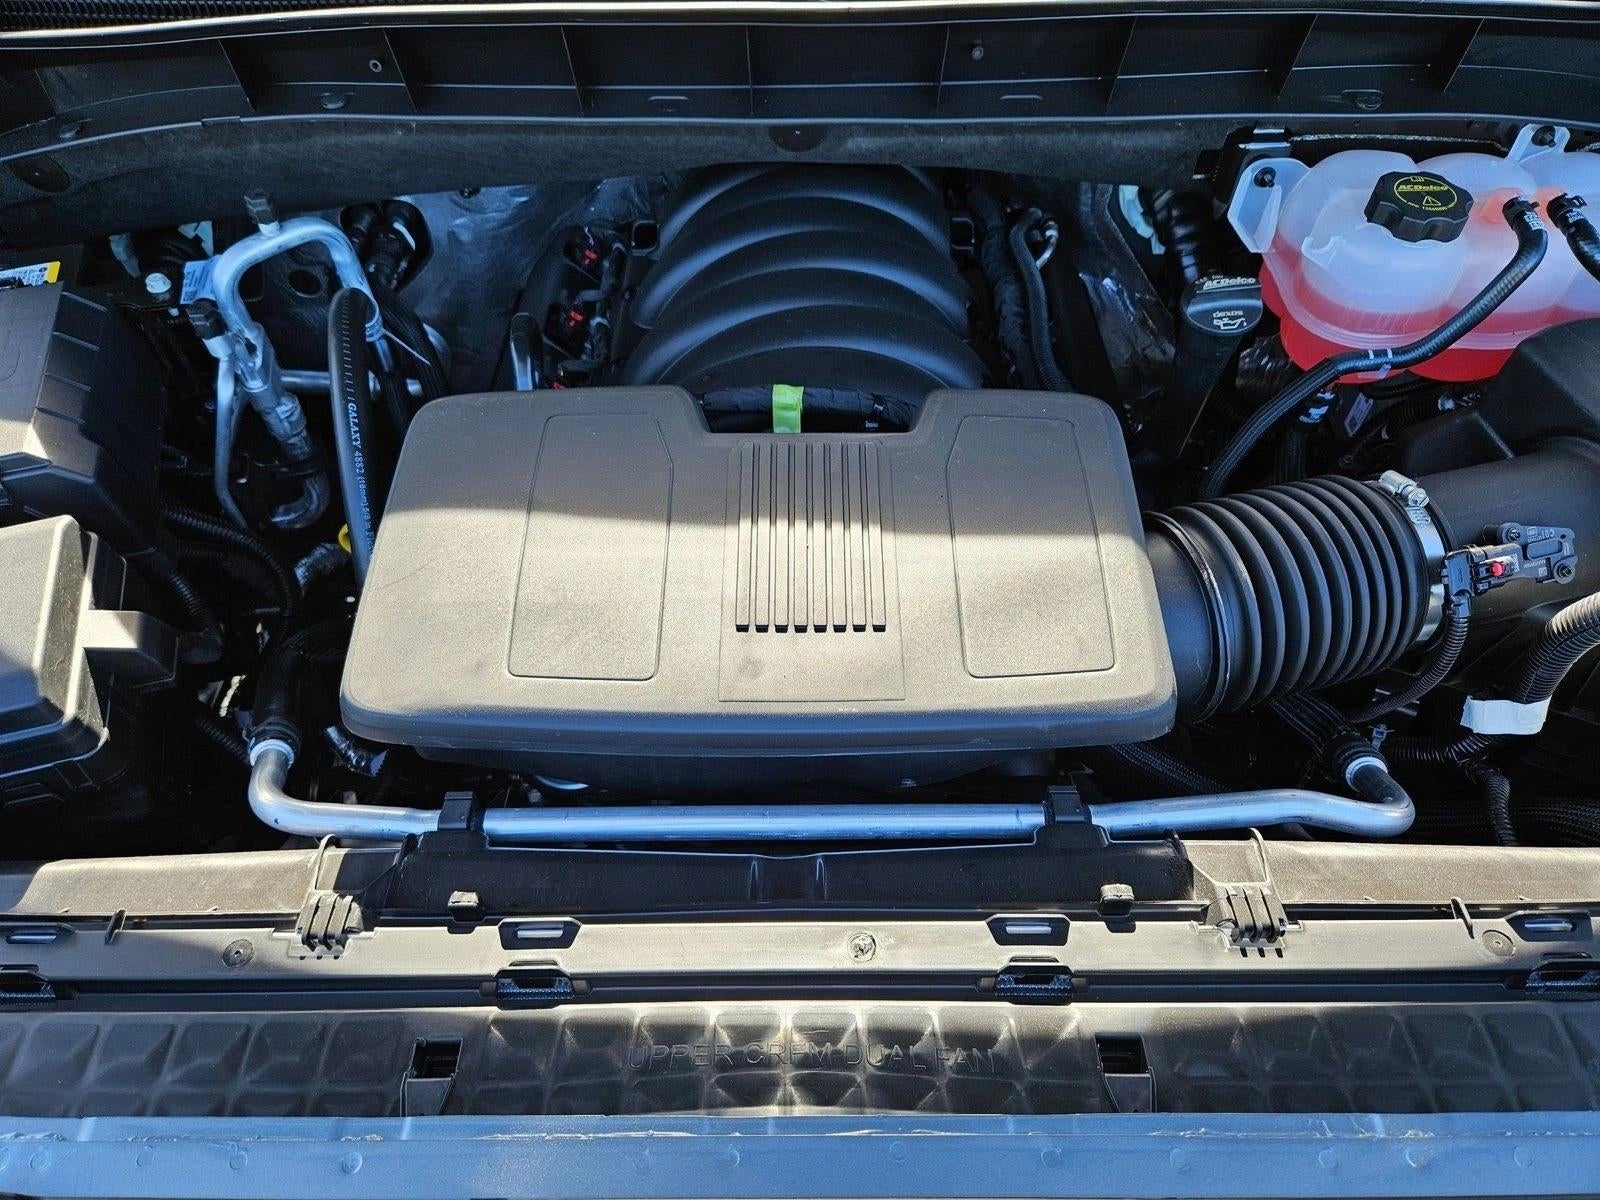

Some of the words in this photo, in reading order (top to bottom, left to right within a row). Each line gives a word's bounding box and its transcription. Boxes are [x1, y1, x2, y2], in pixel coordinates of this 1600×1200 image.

[1397, 184, 1448, 192] ACDelco
[1203, 277, 1256, 290] ACDelco
[348, 402, 361, 449] GALAXY
[353, 450, 365, 474] 4882
[628, 1043, 734, 1070] UPPER
[844, 1044, 927, 1070] DUAL
[933, 1046, 994, 1073] FAN
